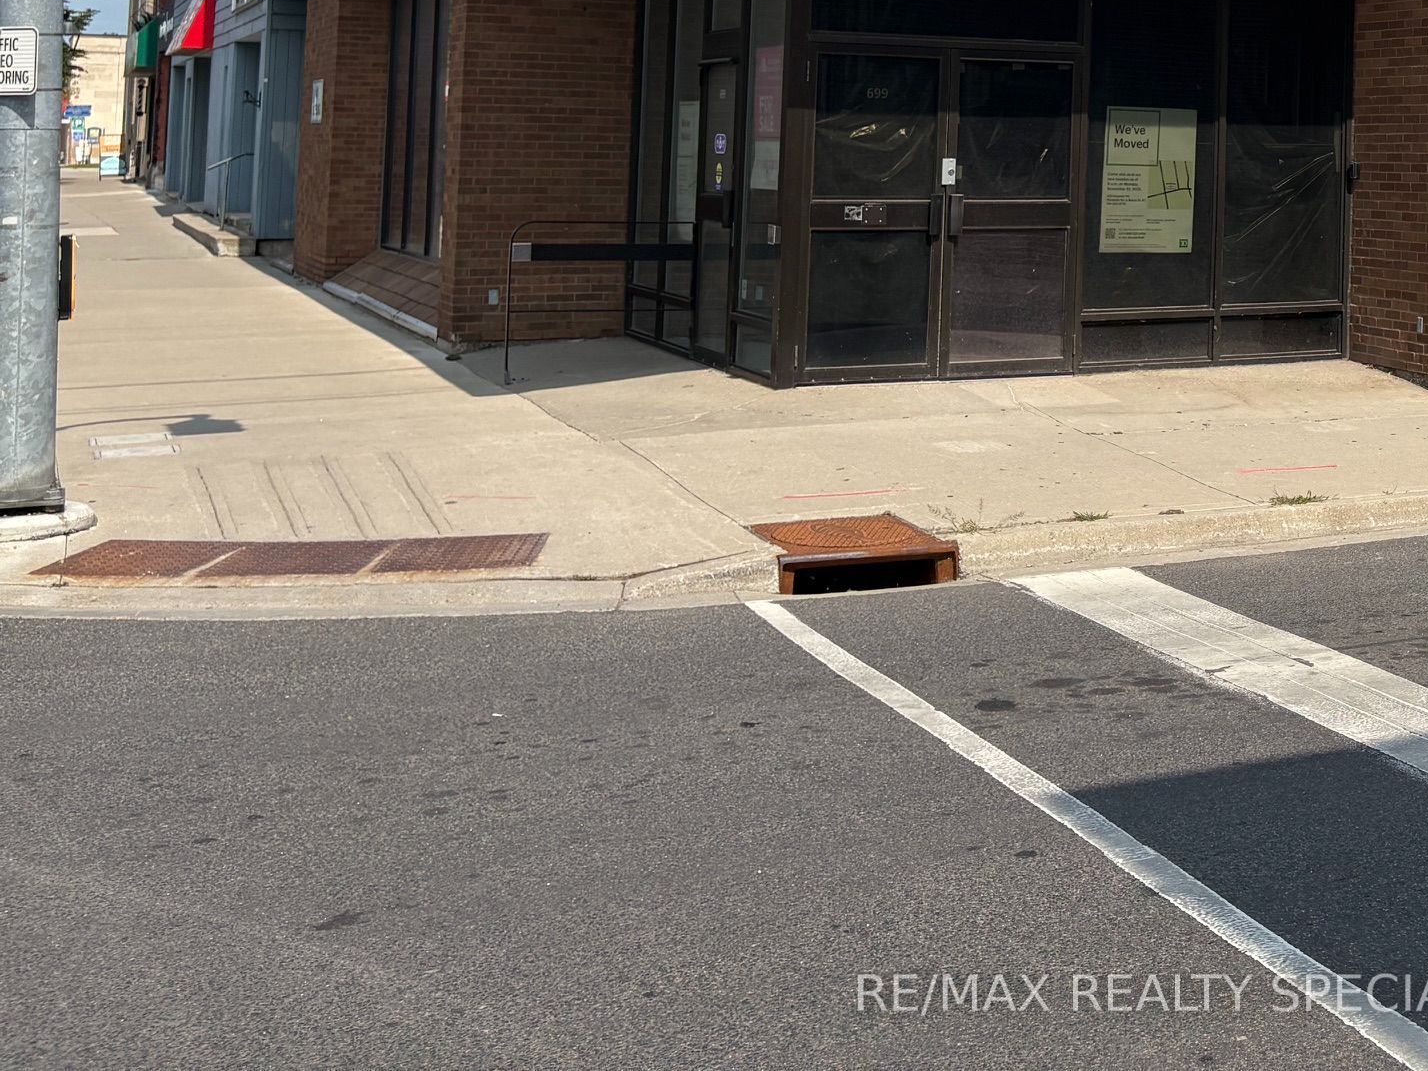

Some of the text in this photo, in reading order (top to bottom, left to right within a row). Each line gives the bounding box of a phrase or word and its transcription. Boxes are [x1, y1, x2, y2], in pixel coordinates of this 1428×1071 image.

[867, 87, 889, 99] 699
[1115, 124, 1146, 135] We've
[1114, 138, 1149, 149] Moved
